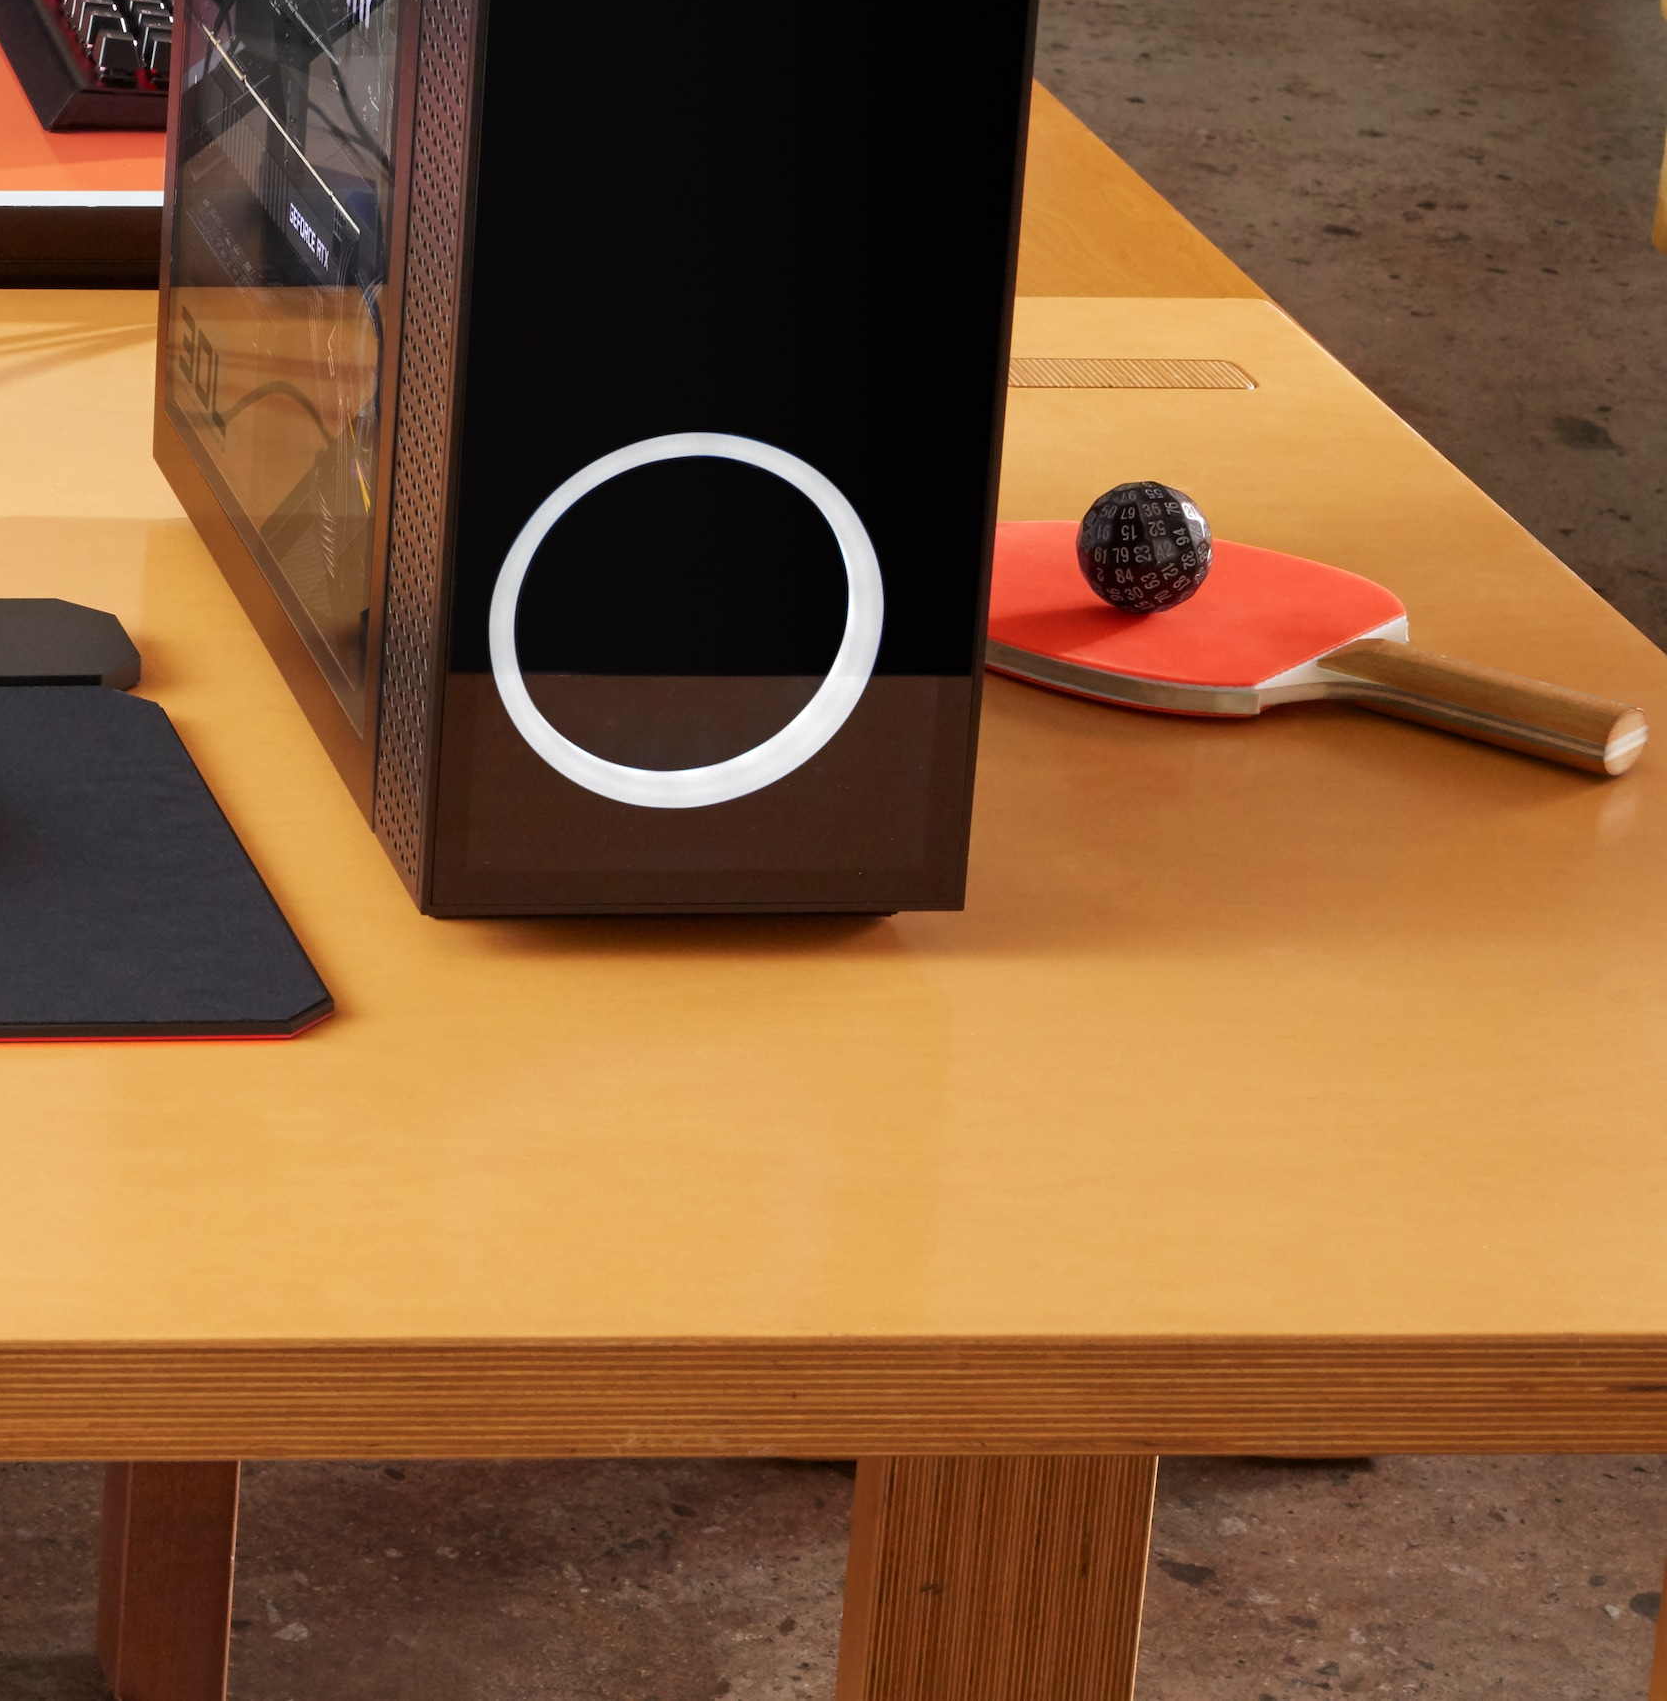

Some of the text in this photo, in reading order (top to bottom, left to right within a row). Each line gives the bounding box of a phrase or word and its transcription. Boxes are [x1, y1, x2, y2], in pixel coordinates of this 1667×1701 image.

[289, 202, 330, 271] GEFORCE RTX
[178, 304, 226, 438] 30L
[1142, 502, 1161, 517] 36
[1112, 547, 1129, 563] 79
[1133, 544, 1152, 563] 23
[1157, 541, 1172, 558] 42
[1181, 551, 1196, 570] 32
[1115, 568, 1135, 584] 84
[1125, 586, 1143, 600] 30
